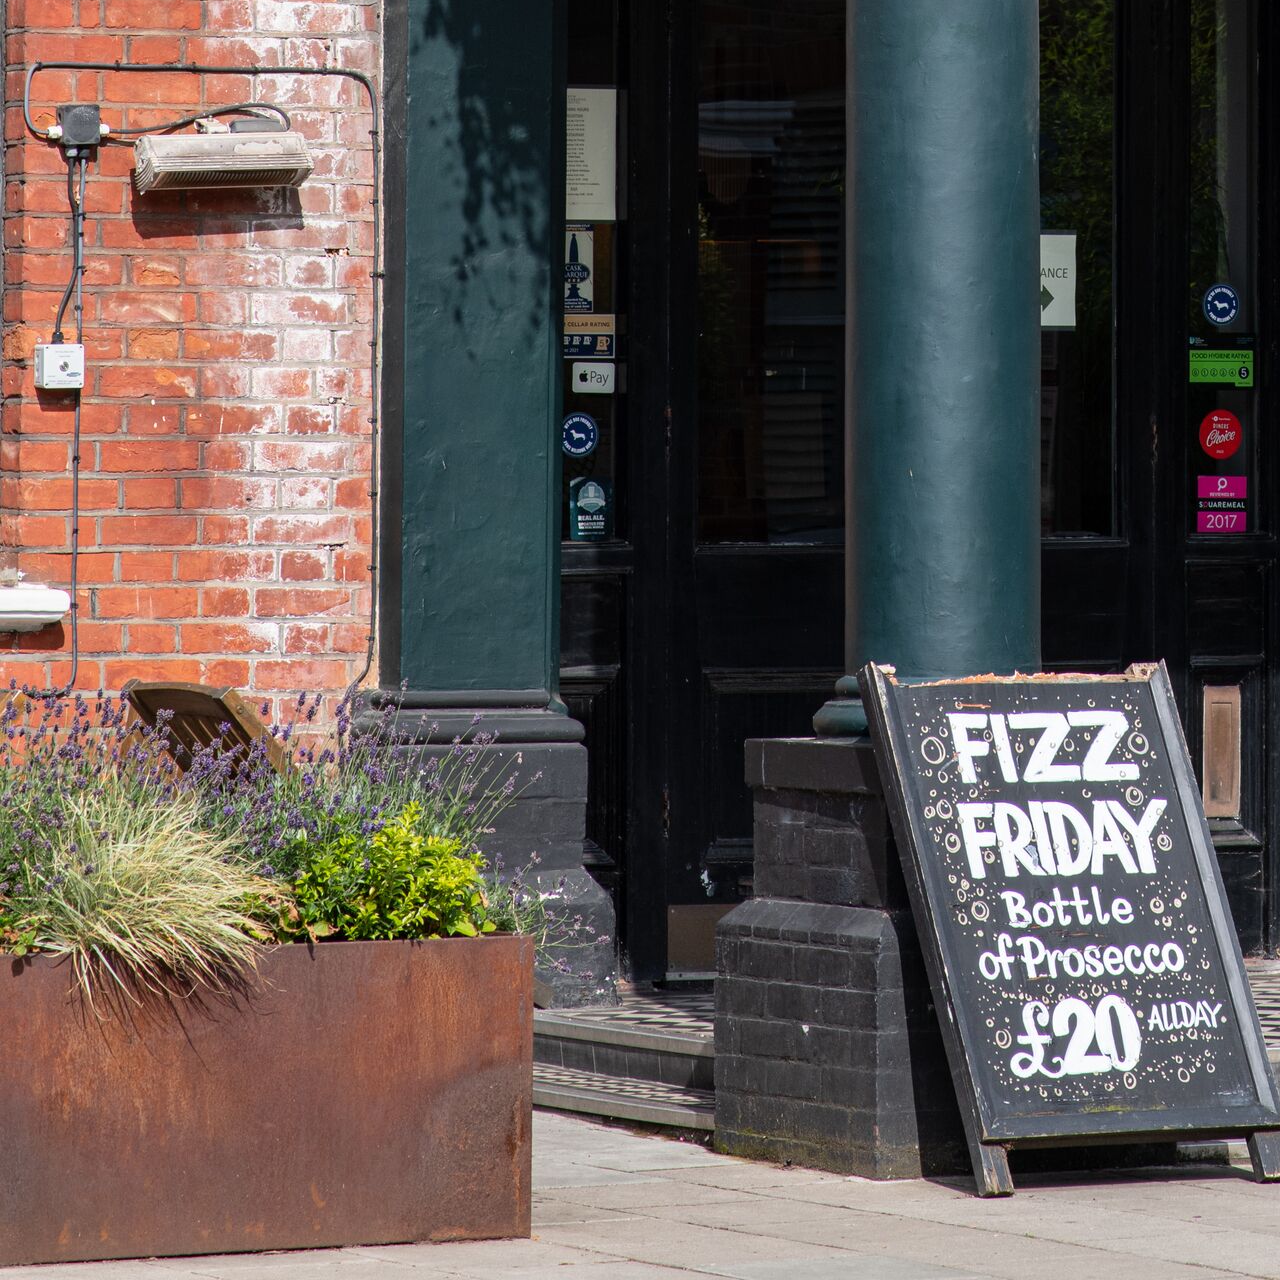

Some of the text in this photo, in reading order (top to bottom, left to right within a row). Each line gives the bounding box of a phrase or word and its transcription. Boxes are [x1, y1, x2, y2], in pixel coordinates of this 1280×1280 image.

[1040, 267, 1069, 279] ANCE
[590, 370, 610, 386] Pay
[1240, 367, 1248, 378] 5
[1206, 429, 1236, 447] Choice
[1206, 514, 1238, 529] 2017
[945, 709, 1141, 784] FIZZ
[955, 799, 1168, 880] FRIDAY
[1000, 885, 1135, 928] Bottle
[978, 933, 1186, 981] of Prosecco
[1010, 994, 1142, 1079] £20
